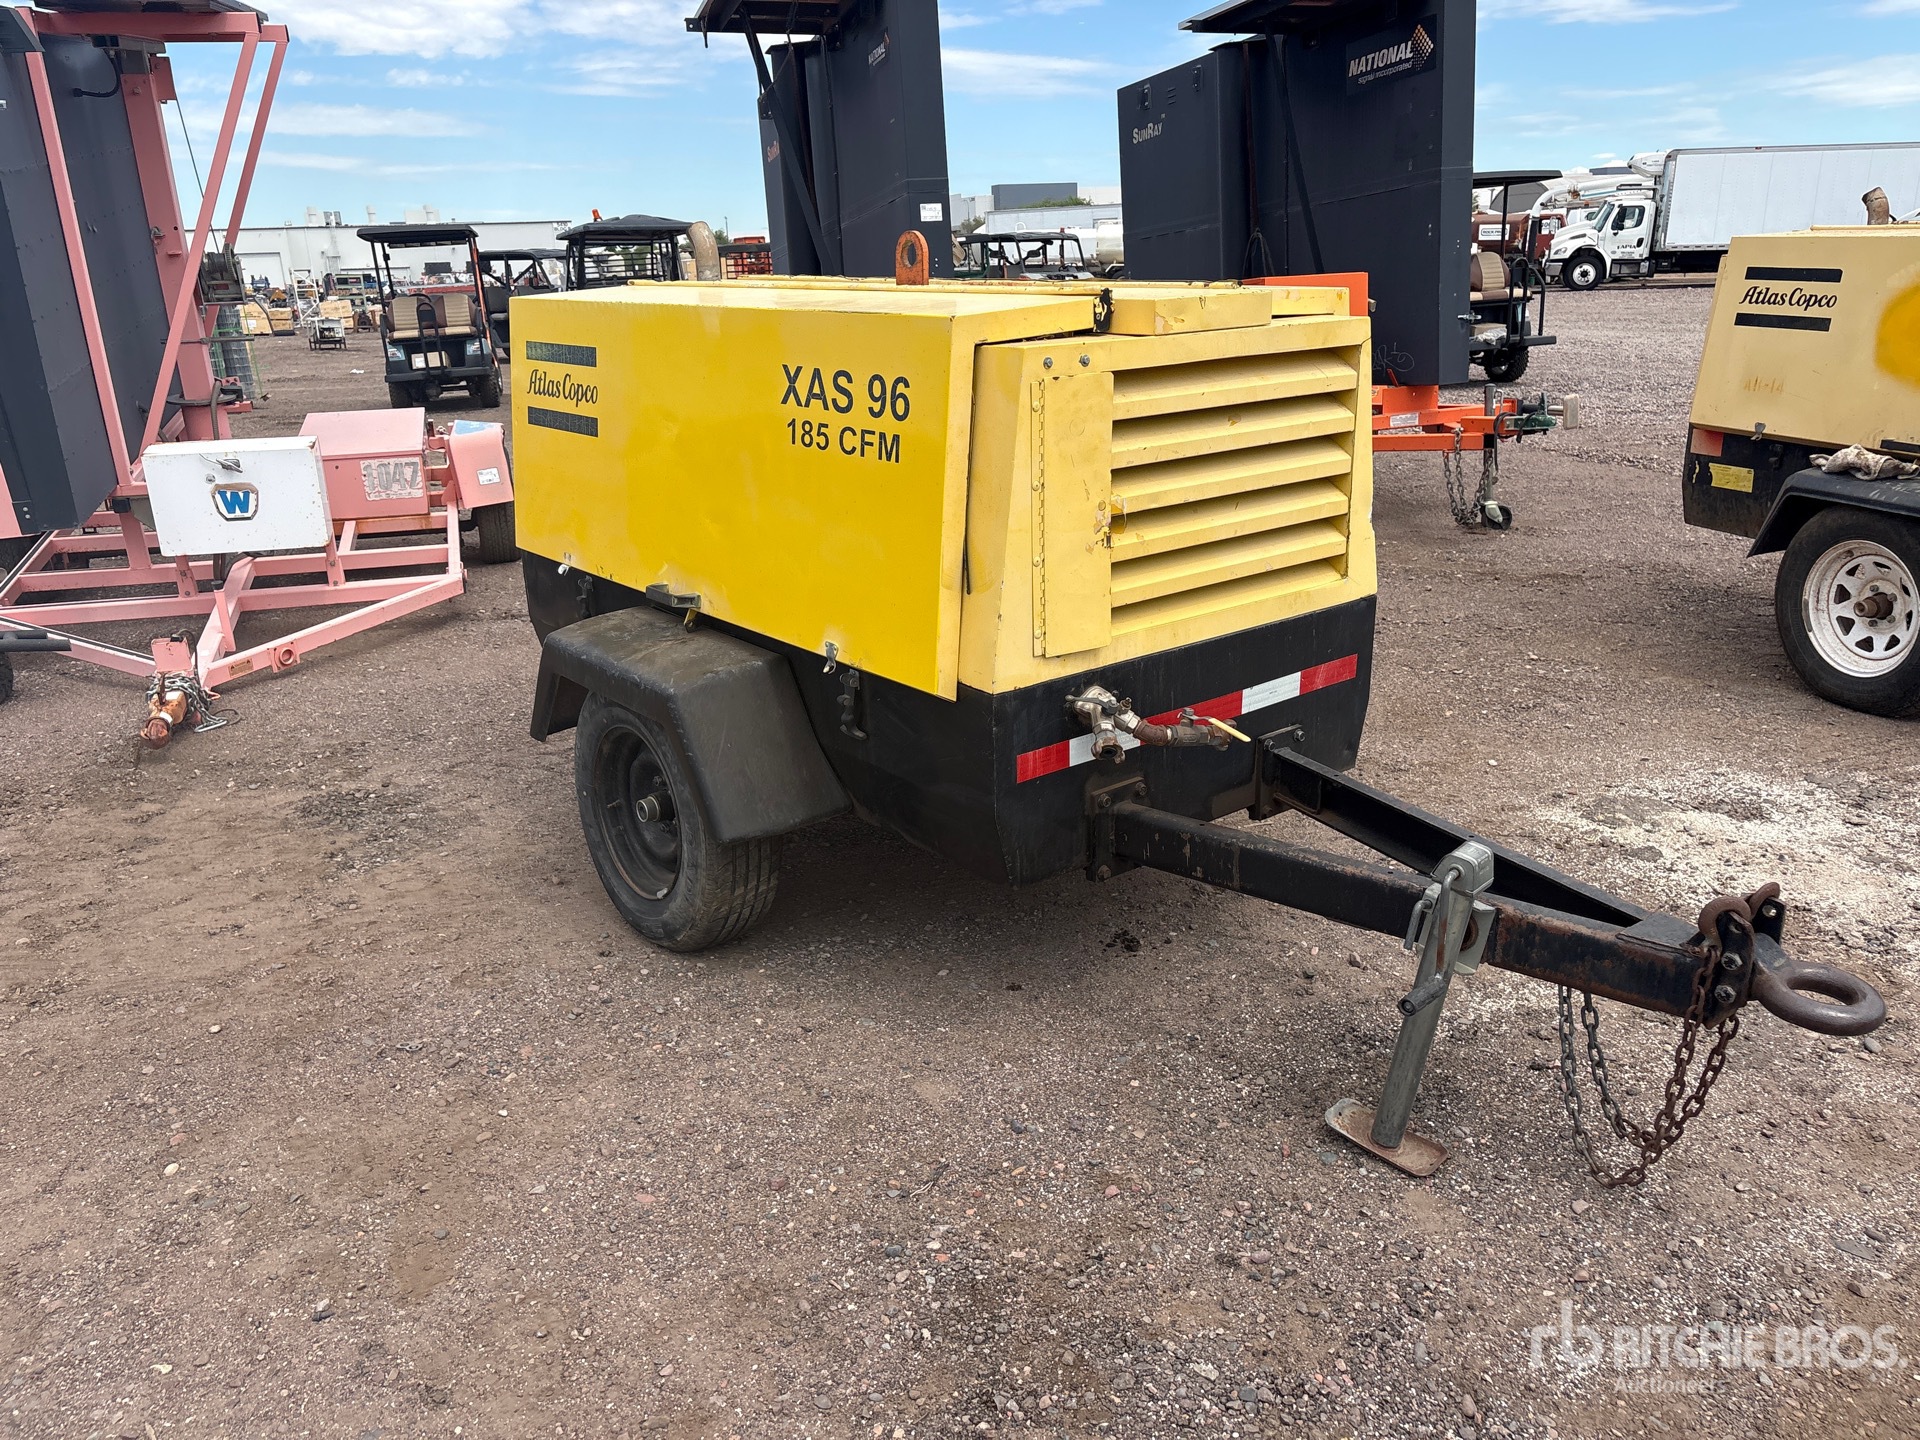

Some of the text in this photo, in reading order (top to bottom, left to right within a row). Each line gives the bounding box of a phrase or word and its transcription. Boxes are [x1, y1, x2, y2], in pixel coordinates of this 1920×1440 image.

[1349, 41, 1414, 77] NATIONAL
[1358, 59, 1413, 84] signal incorporated
[1739, 284, 1838, 312] Atlas Copco
[527, 369, 598, 408] Atlas Copco
[780, 363, 911, 422] XAS 96
[787, 417, 901, 464] 185 CFM
[217, 490, 250, 515] W
